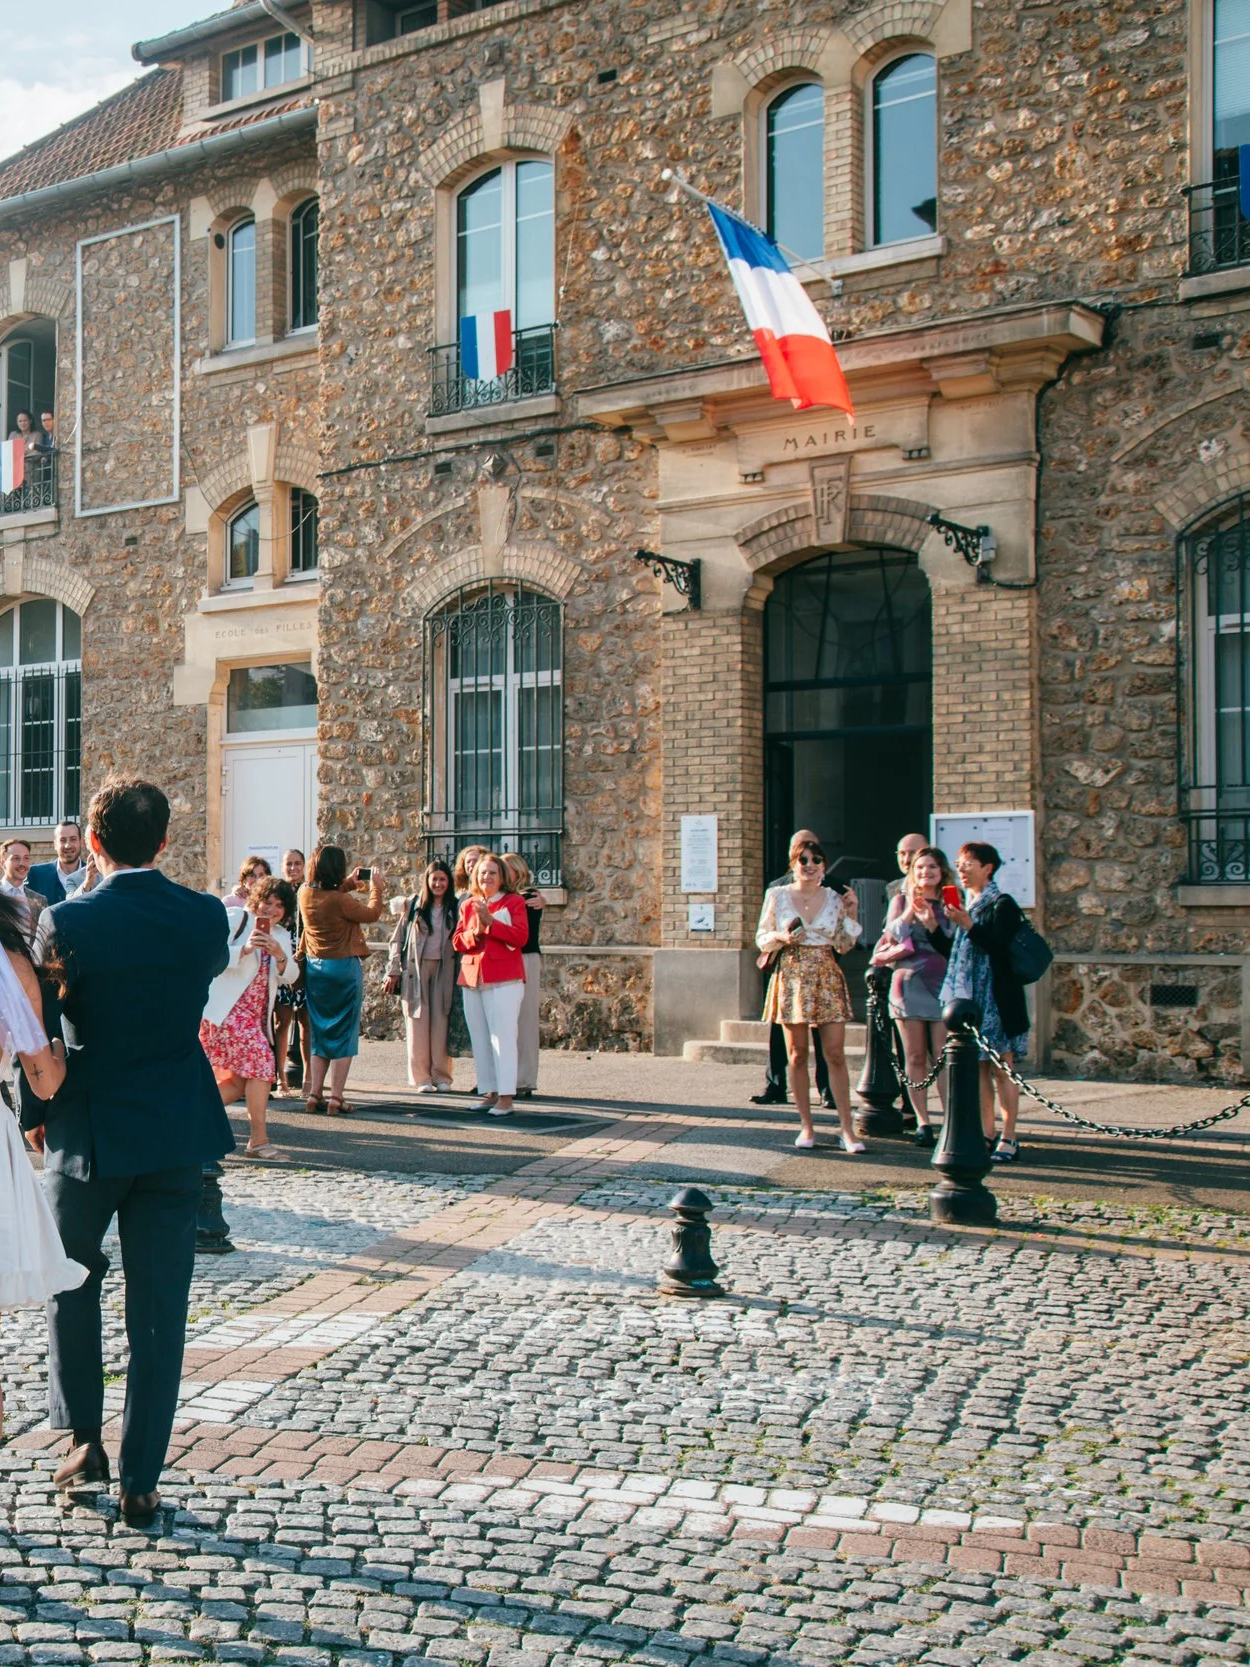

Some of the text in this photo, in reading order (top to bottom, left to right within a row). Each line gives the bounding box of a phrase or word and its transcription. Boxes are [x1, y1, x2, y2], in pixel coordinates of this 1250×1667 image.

[783, 424, 876, 451] MAIRIE
[214, 628, 247, 640] ECOLE
[275, 621, 313, 634] FILLES
